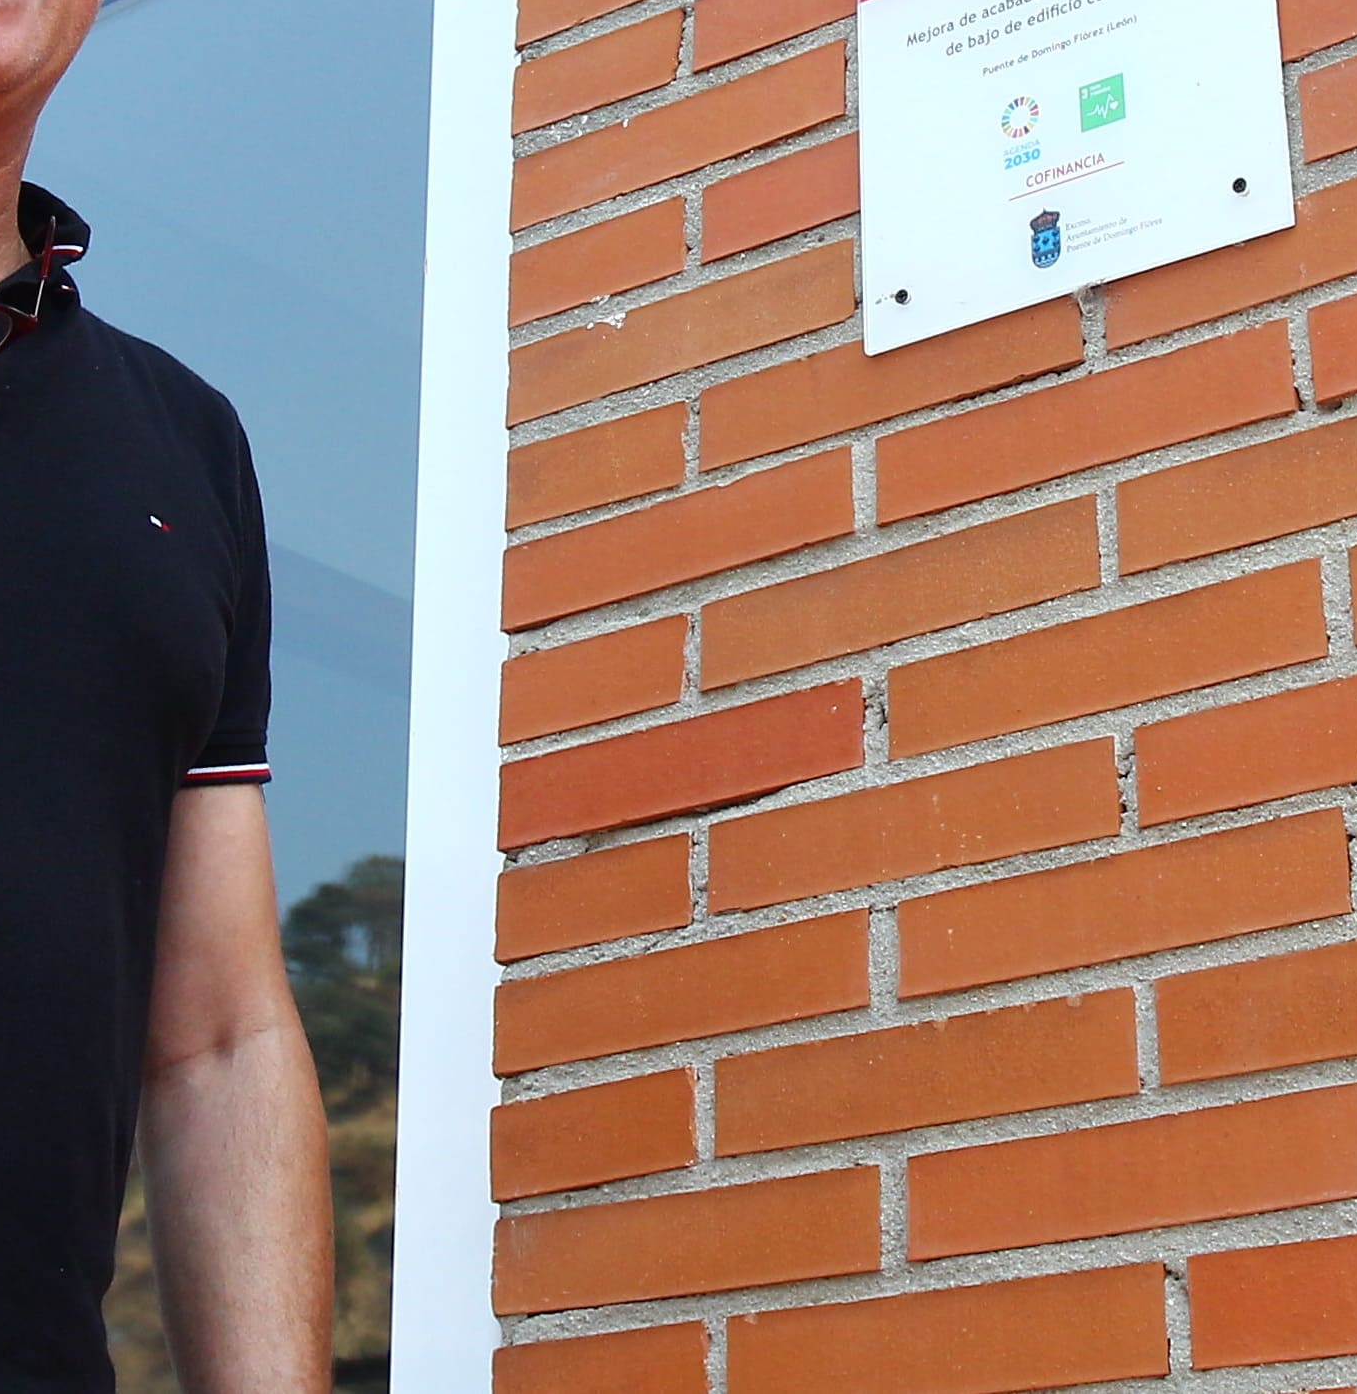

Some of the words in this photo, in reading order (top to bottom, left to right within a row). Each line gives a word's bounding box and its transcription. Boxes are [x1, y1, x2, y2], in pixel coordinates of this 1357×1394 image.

[906, 21, 955, 47] Mejora
[959, 12, 977, 27] de
[945, 41, 963, 56] de
[967, 28, 999, 49] bajo
[1004, 19, 1022, 35] de
[982, 59, 1015, 77] Puente
[1017, 53, 1029, 64] de
[1031, 39, 1071, 59] Domingo
[1073, 27, 1103, 44] Flórez
[1106, 14, 1137, 33] (León)
[1004, 147, 1041, 170] 2030
[1025, 152, 1105, 188] COFINANCIA
